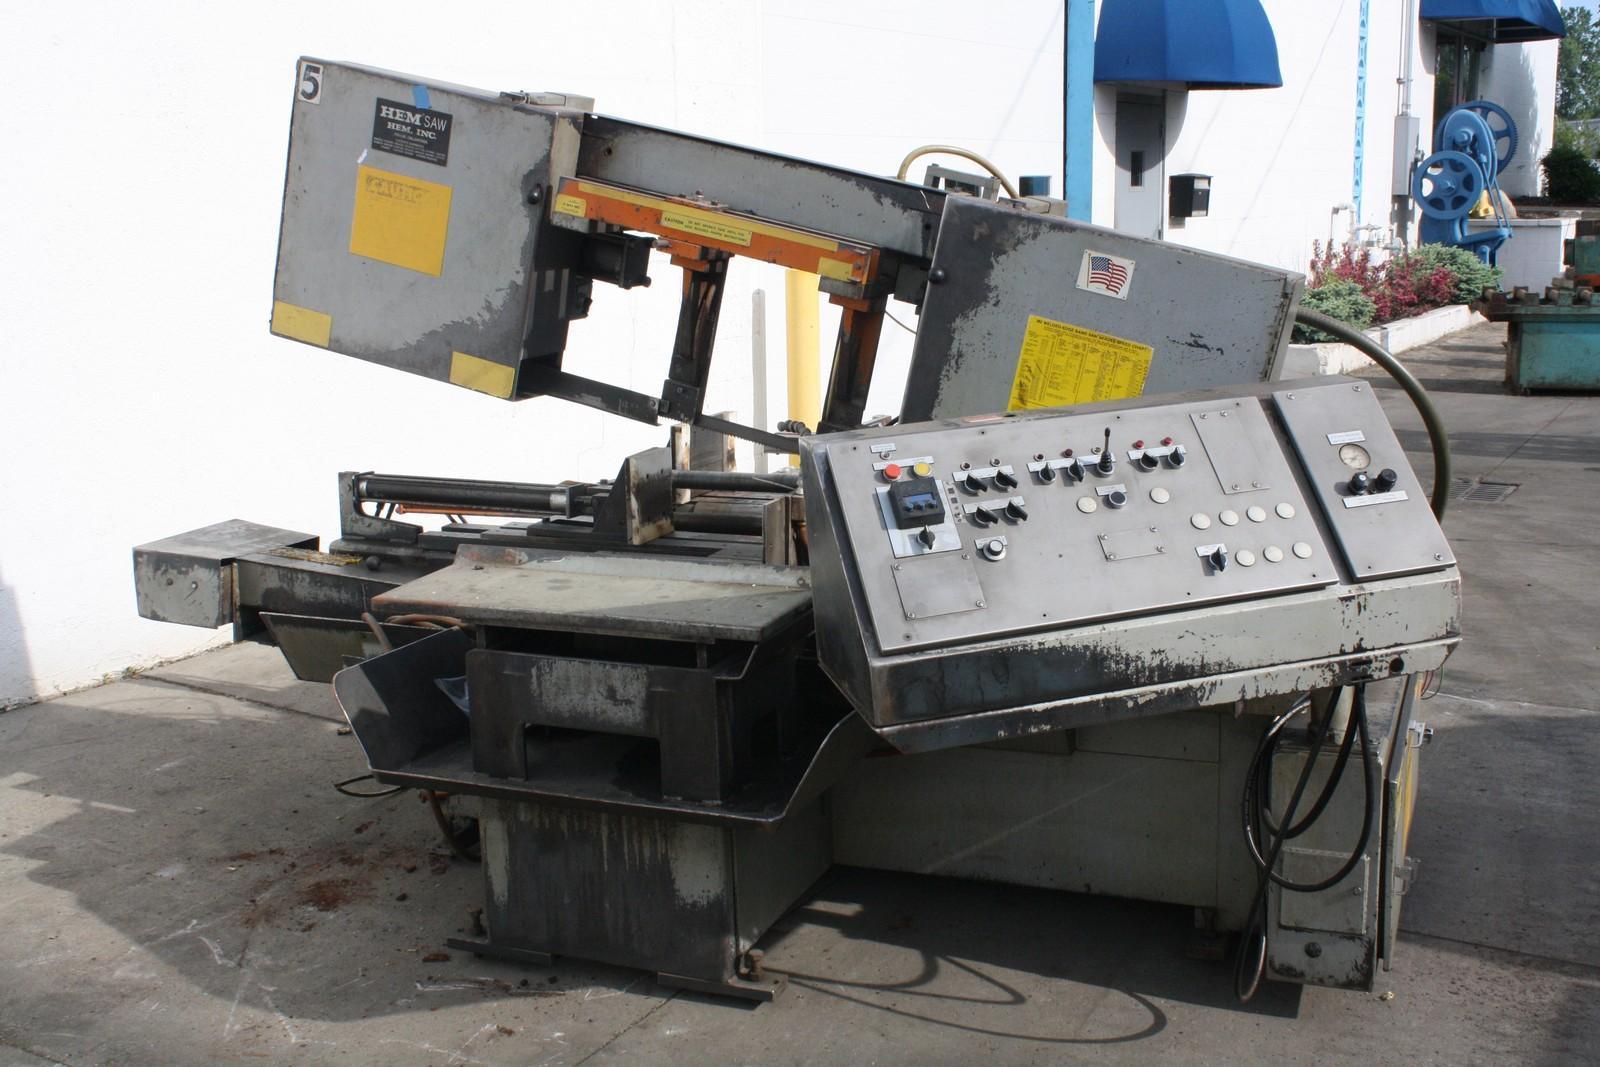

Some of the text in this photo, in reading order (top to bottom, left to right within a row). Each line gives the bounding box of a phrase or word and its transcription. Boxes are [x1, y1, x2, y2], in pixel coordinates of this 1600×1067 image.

[301, 64, 320, 100] 5
[380, 106, 447, 131] HEM SAW
